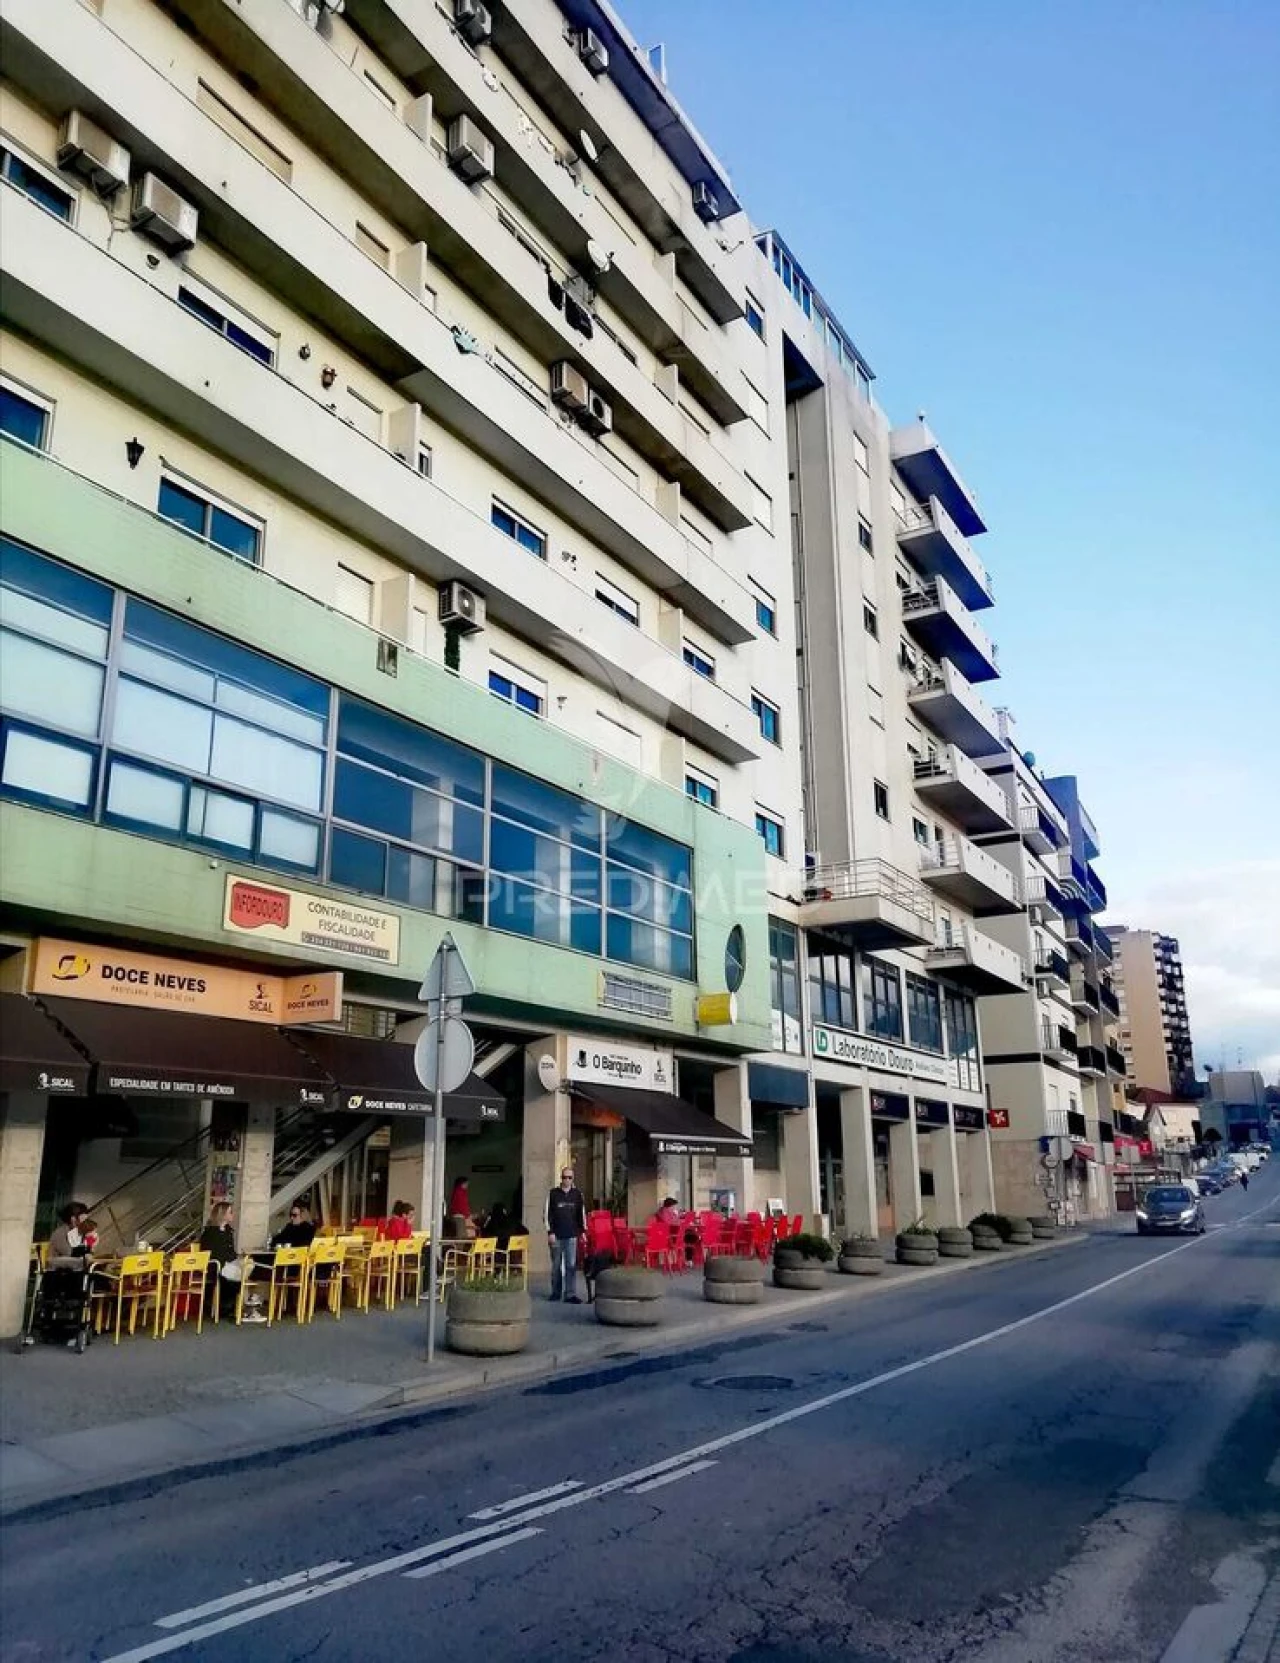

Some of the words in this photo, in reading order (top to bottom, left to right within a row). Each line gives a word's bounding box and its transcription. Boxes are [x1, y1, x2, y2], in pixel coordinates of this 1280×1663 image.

[308, 901, 380, 928] CONTABILIDADE
[319, 918, 376, 941] FISCALIDADE
[101, 964, 149, 985] DOCE
[154, 972, 206, 993] NEVES
[248, 1000, 273, 1014] SICAL
[593, 1054, 600, 1069] O
[832, 1035, 886, 1066] Laboratório
[888, 1049, 914, 1071] Douro
[51, 1077, 75, 1088] SICAL
